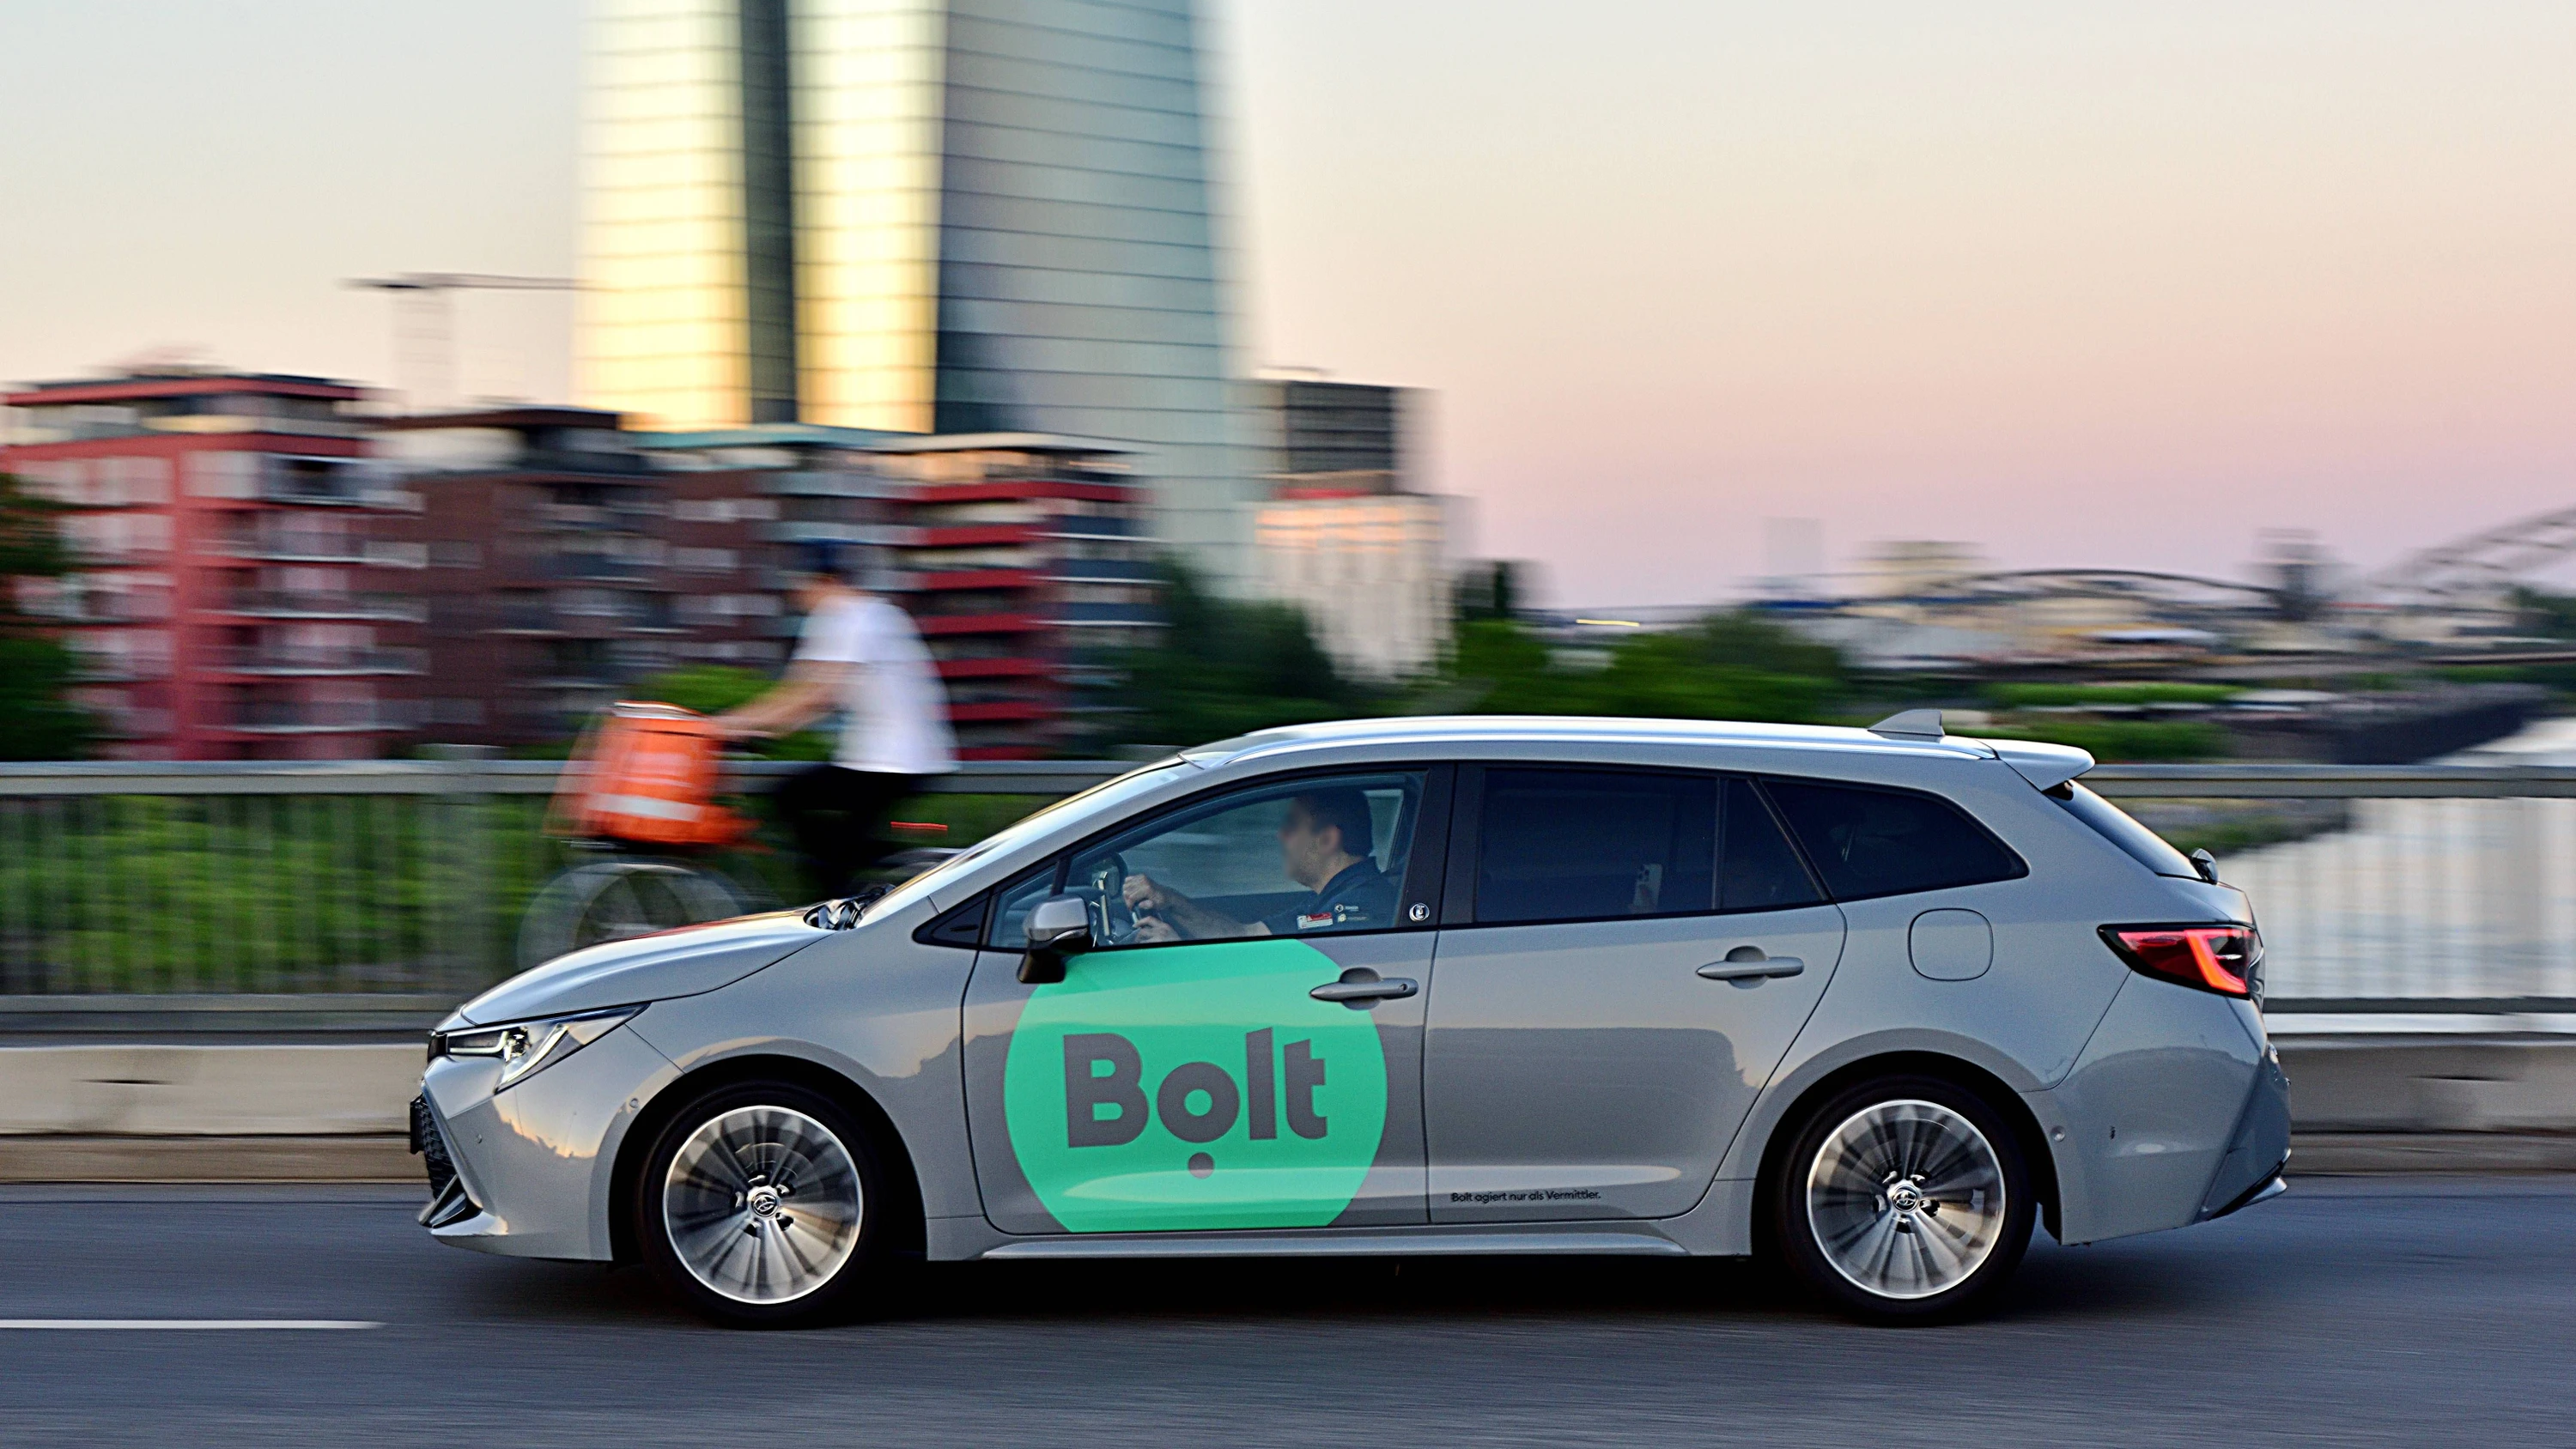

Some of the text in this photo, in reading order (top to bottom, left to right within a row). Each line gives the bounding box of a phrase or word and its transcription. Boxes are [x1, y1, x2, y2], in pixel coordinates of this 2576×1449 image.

[1064, 1027, 1328, 1179] Bolt
[1451, 1189, 1601, 1203] Bolt agiert nur als Vermittler.
